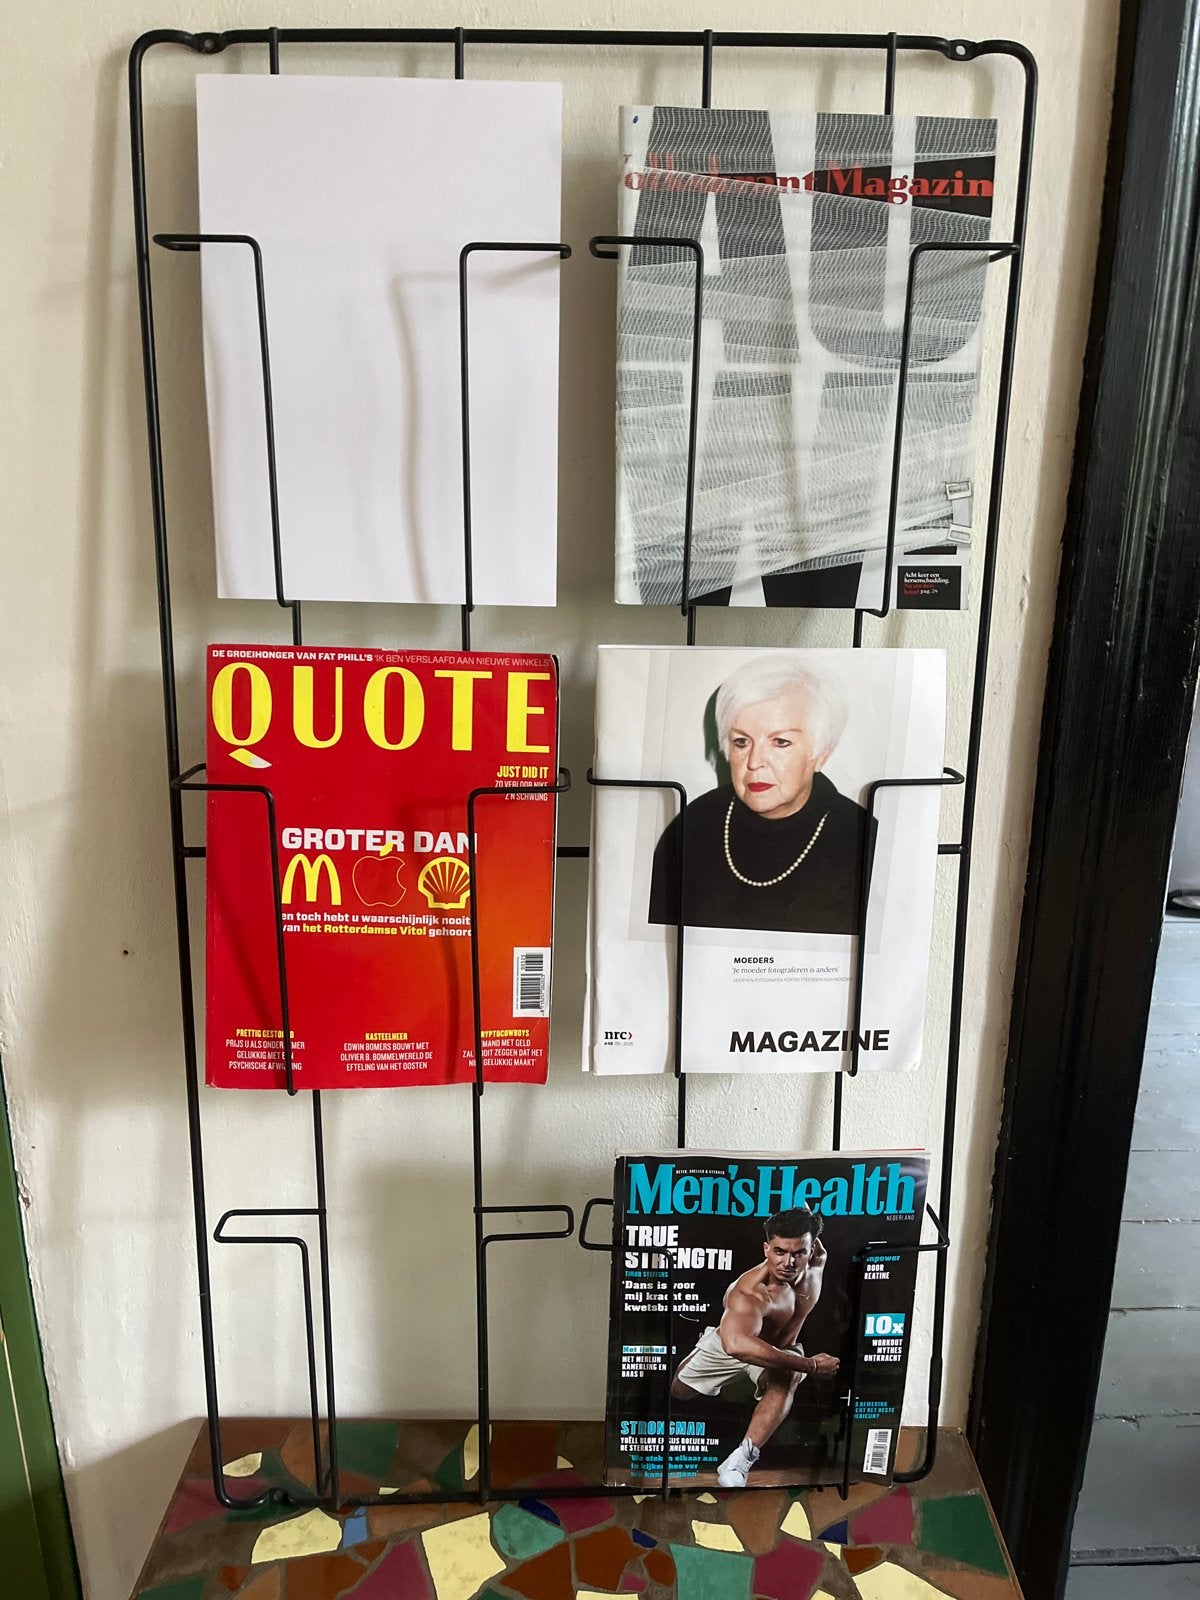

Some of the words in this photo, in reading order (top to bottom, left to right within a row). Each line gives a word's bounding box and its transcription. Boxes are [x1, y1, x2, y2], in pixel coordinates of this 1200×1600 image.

[212, 649, 225, 658] DE
[226, 650, 295, 659] GROEIHONGER
[296, 652, 317, 660] VAN
[318, 652, 336, 661] FAT
[337, 652, 373, 662] PHILL'S
[386, 654, 404, 663] BEN
[405, 655, 455, 664] VERSLAAFD
[456, 656, 475, 665] AAN
[476, 656, 510, 666] NIEUWE
[212, 662, 551, 769] QUOTE
[497, 765, 521, 778] JUST
[522, 766, 538, 778] DID
[540, 766, 549, 778] IT
[516, 792, 548, 801] SCHWUNG
[282, 827, 405, 852] GROTER
[414, 830, 478, 854] DAN
[296, 912, 322, 922] toch
[324, 912, 349, 922] hebt
[351, 915, 359, 923] u
[361, 914, 439, 926] waarschijnlijk
[441, 916, 471, 926] nooit
[303, 923, 322, 933] het
[324, 924, 398, 935] Rotterdamse
[399, 925, 427, 936] Vitol
[768, 966, 808, 974] fotograferen
[236, 1029, 261, 1037] PRETTIG
[262, 1030, 294, 1038] GESTOD
[365, 1032, 408, 1040] KASTEELHEER
[481, 1029, 530, 1038] RYPTOCOWBOYS
[604, 1031, 627, 1040] nrc
[226, 1039, 244, 1047] PRIJS
[245, 1040, 249, 1048] U
[250, 1040, 262, 1048] ALS
[263, 1041, 305, 1049] ONDERMER
[501, 1039, 514, 1047] MET
[515, 1039, 531, 1047] GELD
[729, 1029, 890, 1052] MAGAZINE
[344, 1043, 365, 1051] EDWIN
[365, 1043, 392, 1051] BOMERS
[392, 1042, 415, 1050] BOUWT
[416, 1042, 429, 1050] MET
[236, 1051, 267, 1059] GELUKKIG
[267, 1051, 280, 1059] MET
[282, 1052, 294, 1060] EN
[340, 1053, 364, 1061] OLIVIER
[365, 1053, 372, 1061] B.
[372, 1052, 424, 1061] BOMMELWERELD
[425, 1051, 433, 1059] DE
[462, 1050, 474, 1058] ZAL
[494, 1049, 518, 1057] ZEGGEN
[519, 1049, 530, 1057] DAT
[531, 1049, 543, 1057] HET
[229, 1061, 267, 1070] PSYCHISCHE
[268, 1062, 302, 1071] AFWIING
[346, 1063, 375, 1071] EFTELING
[376, 1063, 389, 1071] VAN
[390, 1062, 402, 1071] HET
[403, 1062, 428, 1070] OOSTEN
[483, 1058, 513, 1066] GELUKKIG
[626, 1225, 679, 1247] TRUE
[867, 1264, 884, 1272] DOOR
[864, 1272, 890, 1280] REATINE
[622, 1280, 653, 1289] 'Dans
[657, 1281, 668, 1289] is
[624, 1292, 643, 1302] mij
[865, 1315, 904, 1335] 10x
[863, 1354, 902, 1362] ONTKRACHT
[620, 1420, 705, 1436] STRONGMAN
[706, 1438, 719, 1446] ZIJN
